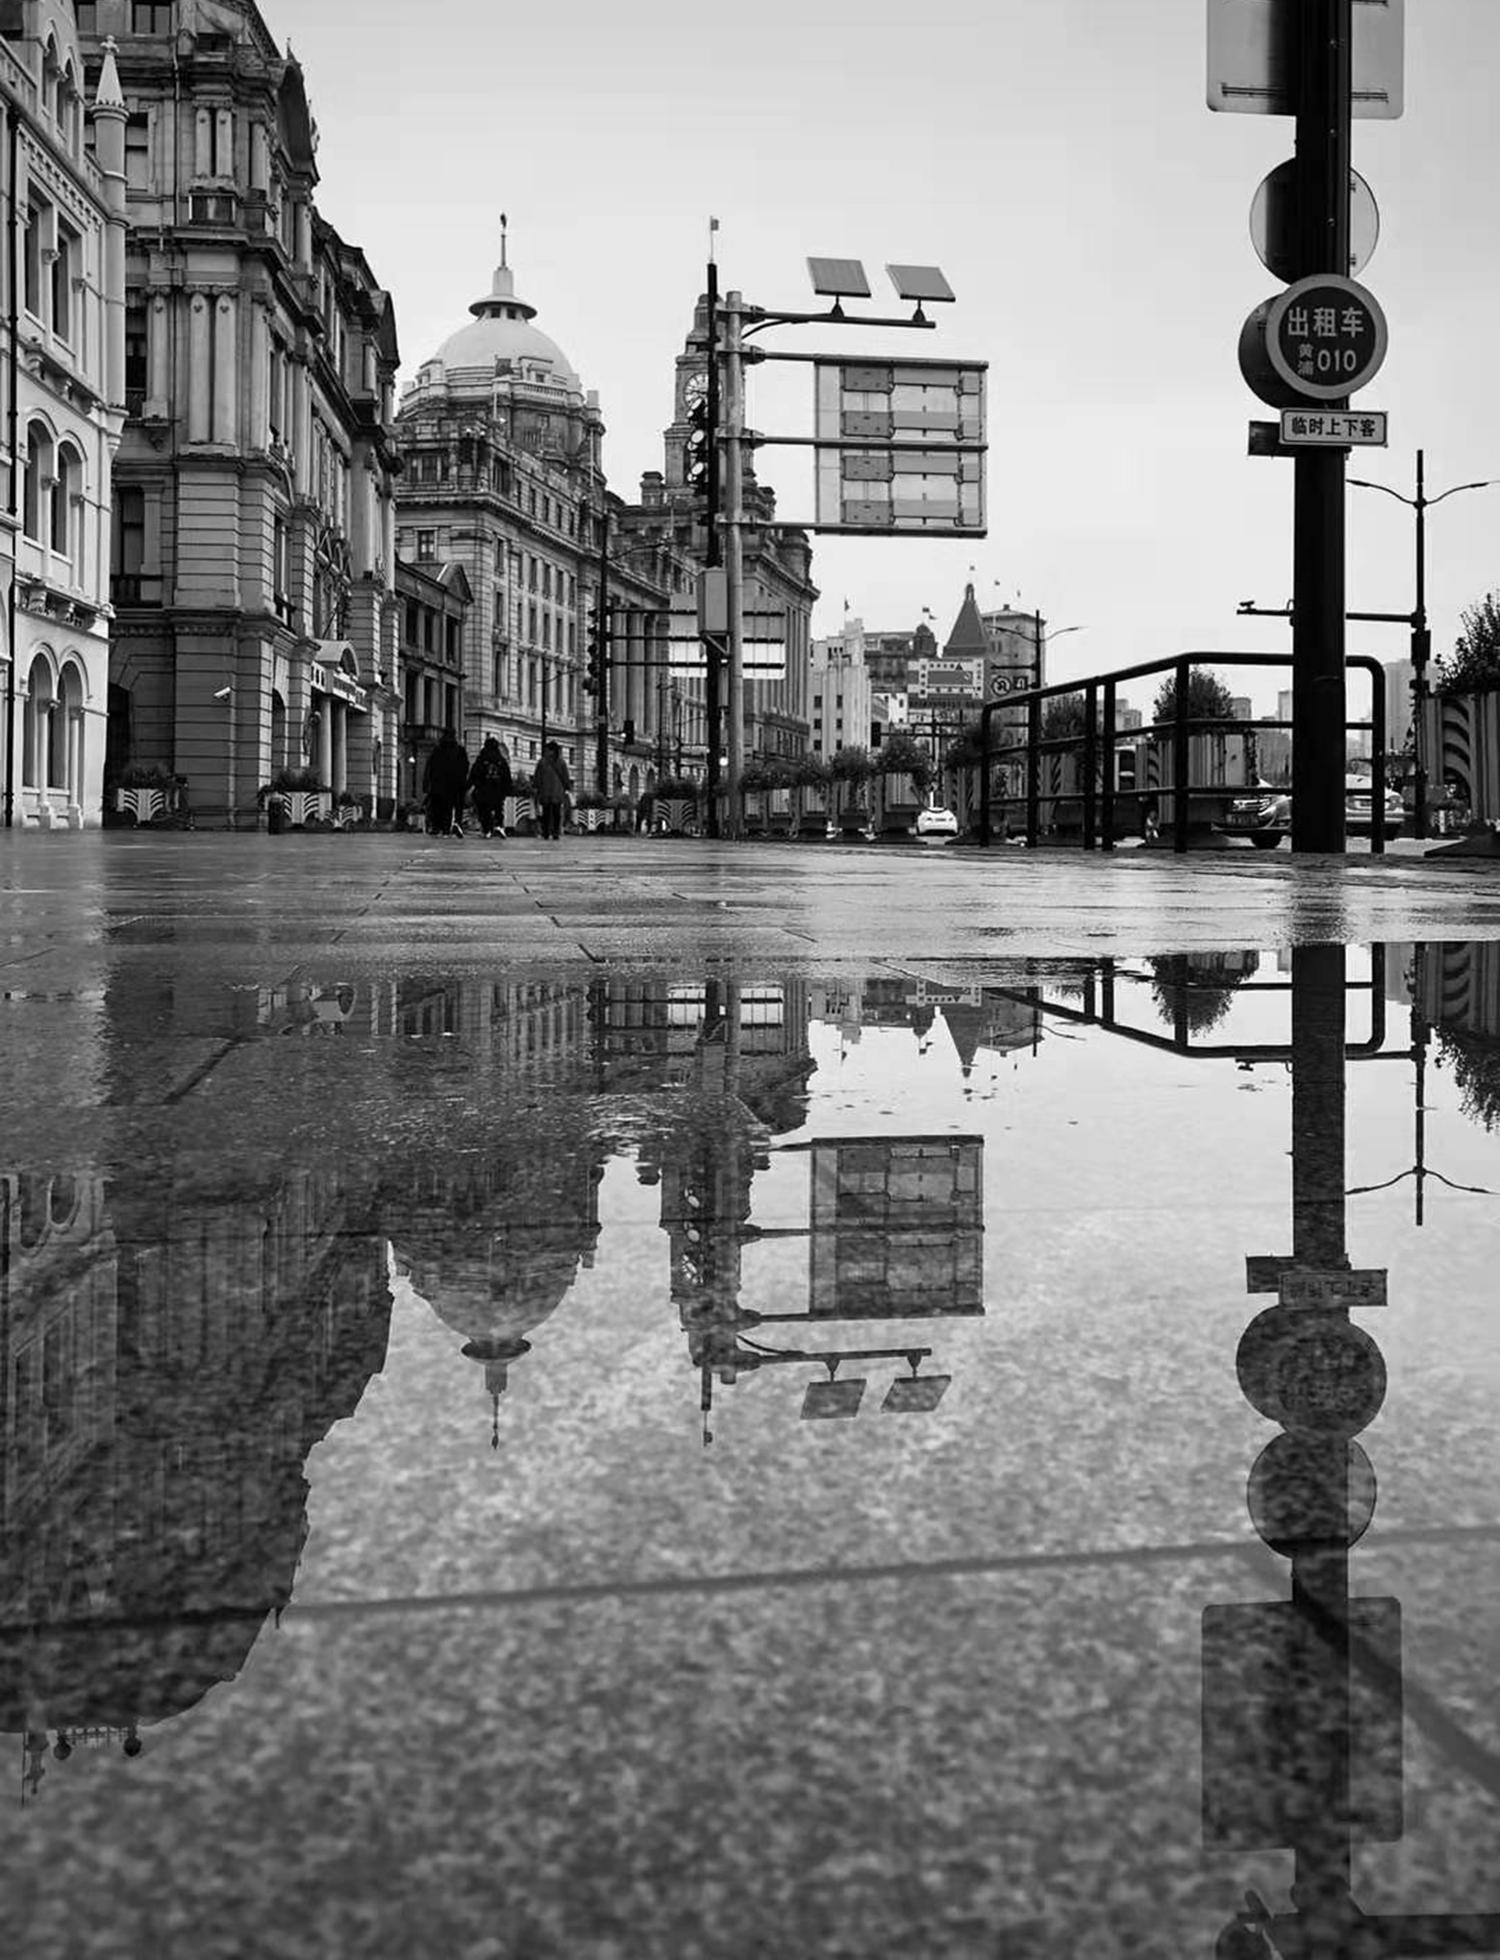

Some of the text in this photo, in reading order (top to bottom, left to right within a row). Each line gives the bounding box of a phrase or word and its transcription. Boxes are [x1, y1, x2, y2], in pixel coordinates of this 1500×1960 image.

[1288, 306, 1364, 338] 出租车
[1317, 349, 1357, 372] 010
[1291, 416, 1375, 437] 临时上下客
